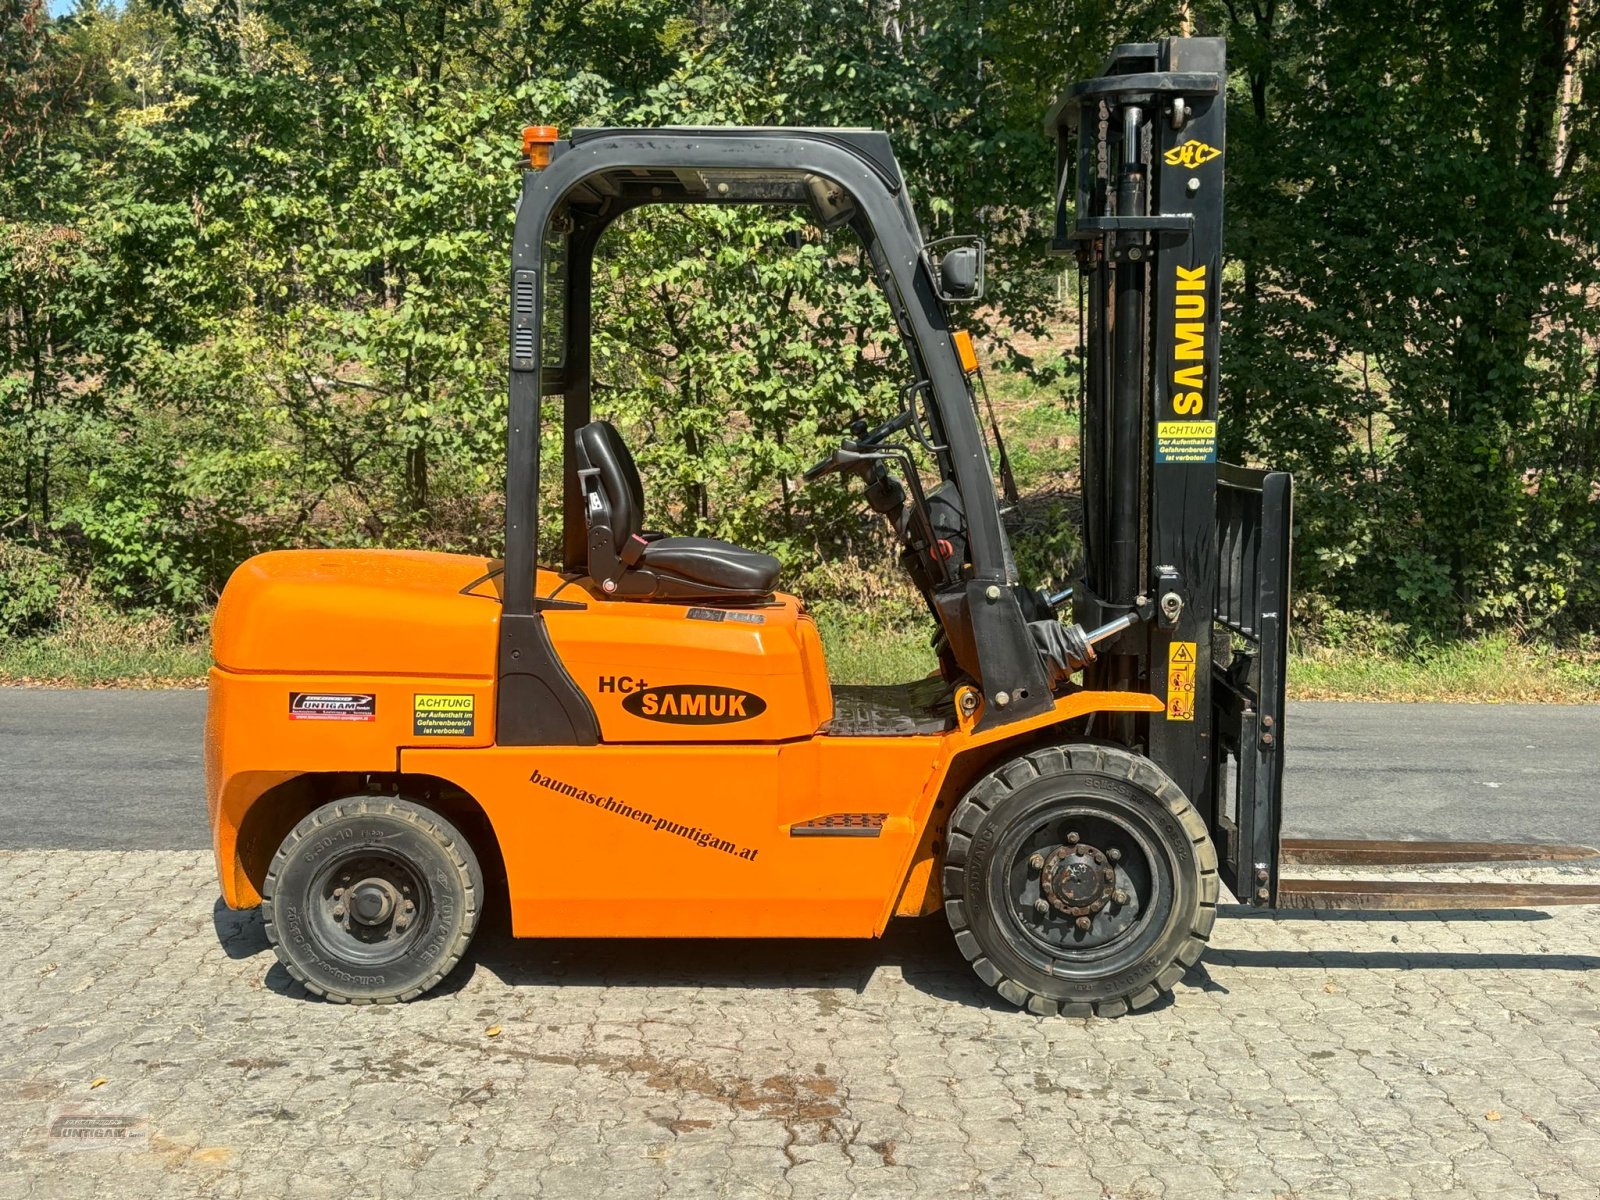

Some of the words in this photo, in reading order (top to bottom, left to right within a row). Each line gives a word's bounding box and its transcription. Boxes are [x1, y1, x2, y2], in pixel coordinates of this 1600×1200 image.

[1173, 265, 1206, 415] SAMUK
[1160, 425, 1214, 435] ACHTUNG
[1158, 438, 1171, 446] Der
[1170, 438, 1206, 446] Aufenthalt
[1206, 438, 1215, 446] im
[1159, 446, 1214, 454] Gefahrenbereich
[598, 675, 649, 694] HC+
[417, 698, 471, 708] ACHTUNG
[641, 693, 748, 718] SAMUK
[428, 711, 464, 719] Aufenthalt
[463, 711, 473, 719] im
[416, 719, 472, 727] Gefahrenbereich
[433, 727, 465, 735] verboten!
[529, 769, 759, 862] baumaschinen-puntigam.at
